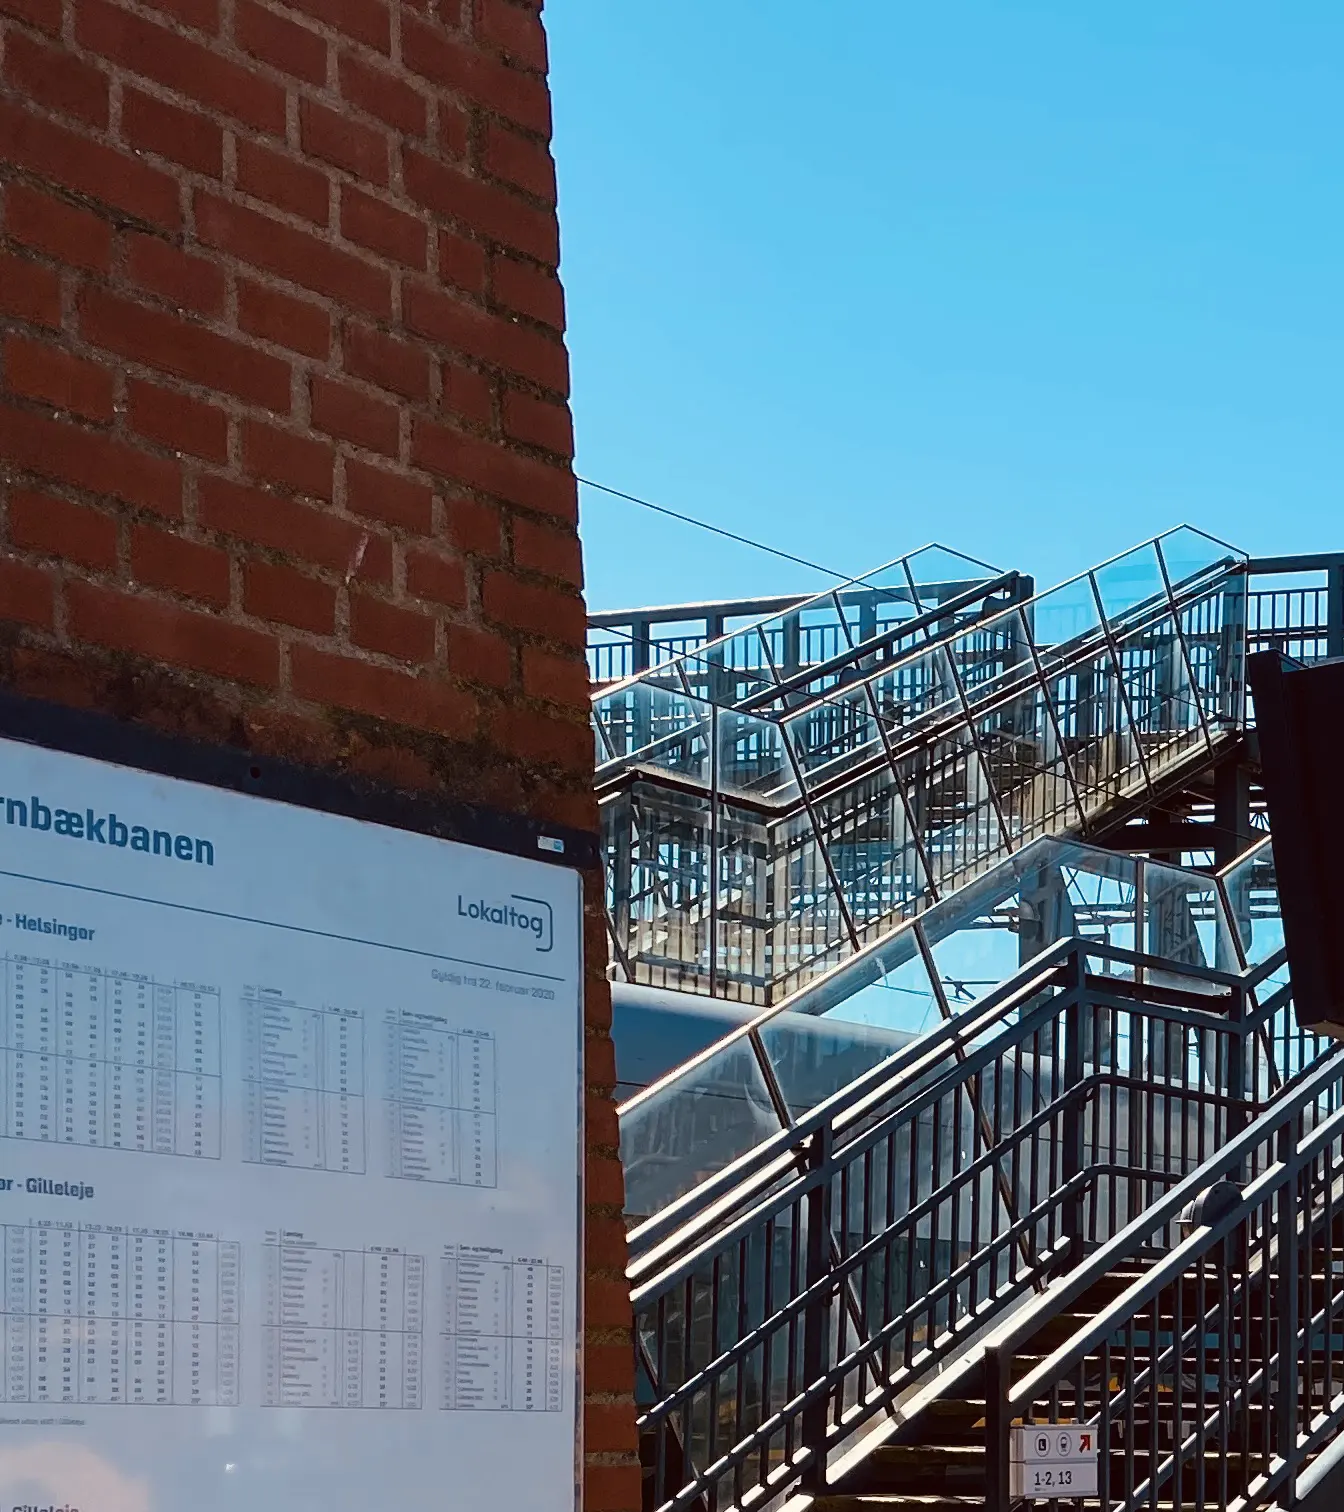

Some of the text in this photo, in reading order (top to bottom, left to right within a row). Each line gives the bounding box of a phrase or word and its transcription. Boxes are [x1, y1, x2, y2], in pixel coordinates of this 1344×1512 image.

[458, 895, 543, 938] Lokaltog
[26, 1177, 94, 1200] Gilleleje
[1058, 1470, 1072, 1485] 13
